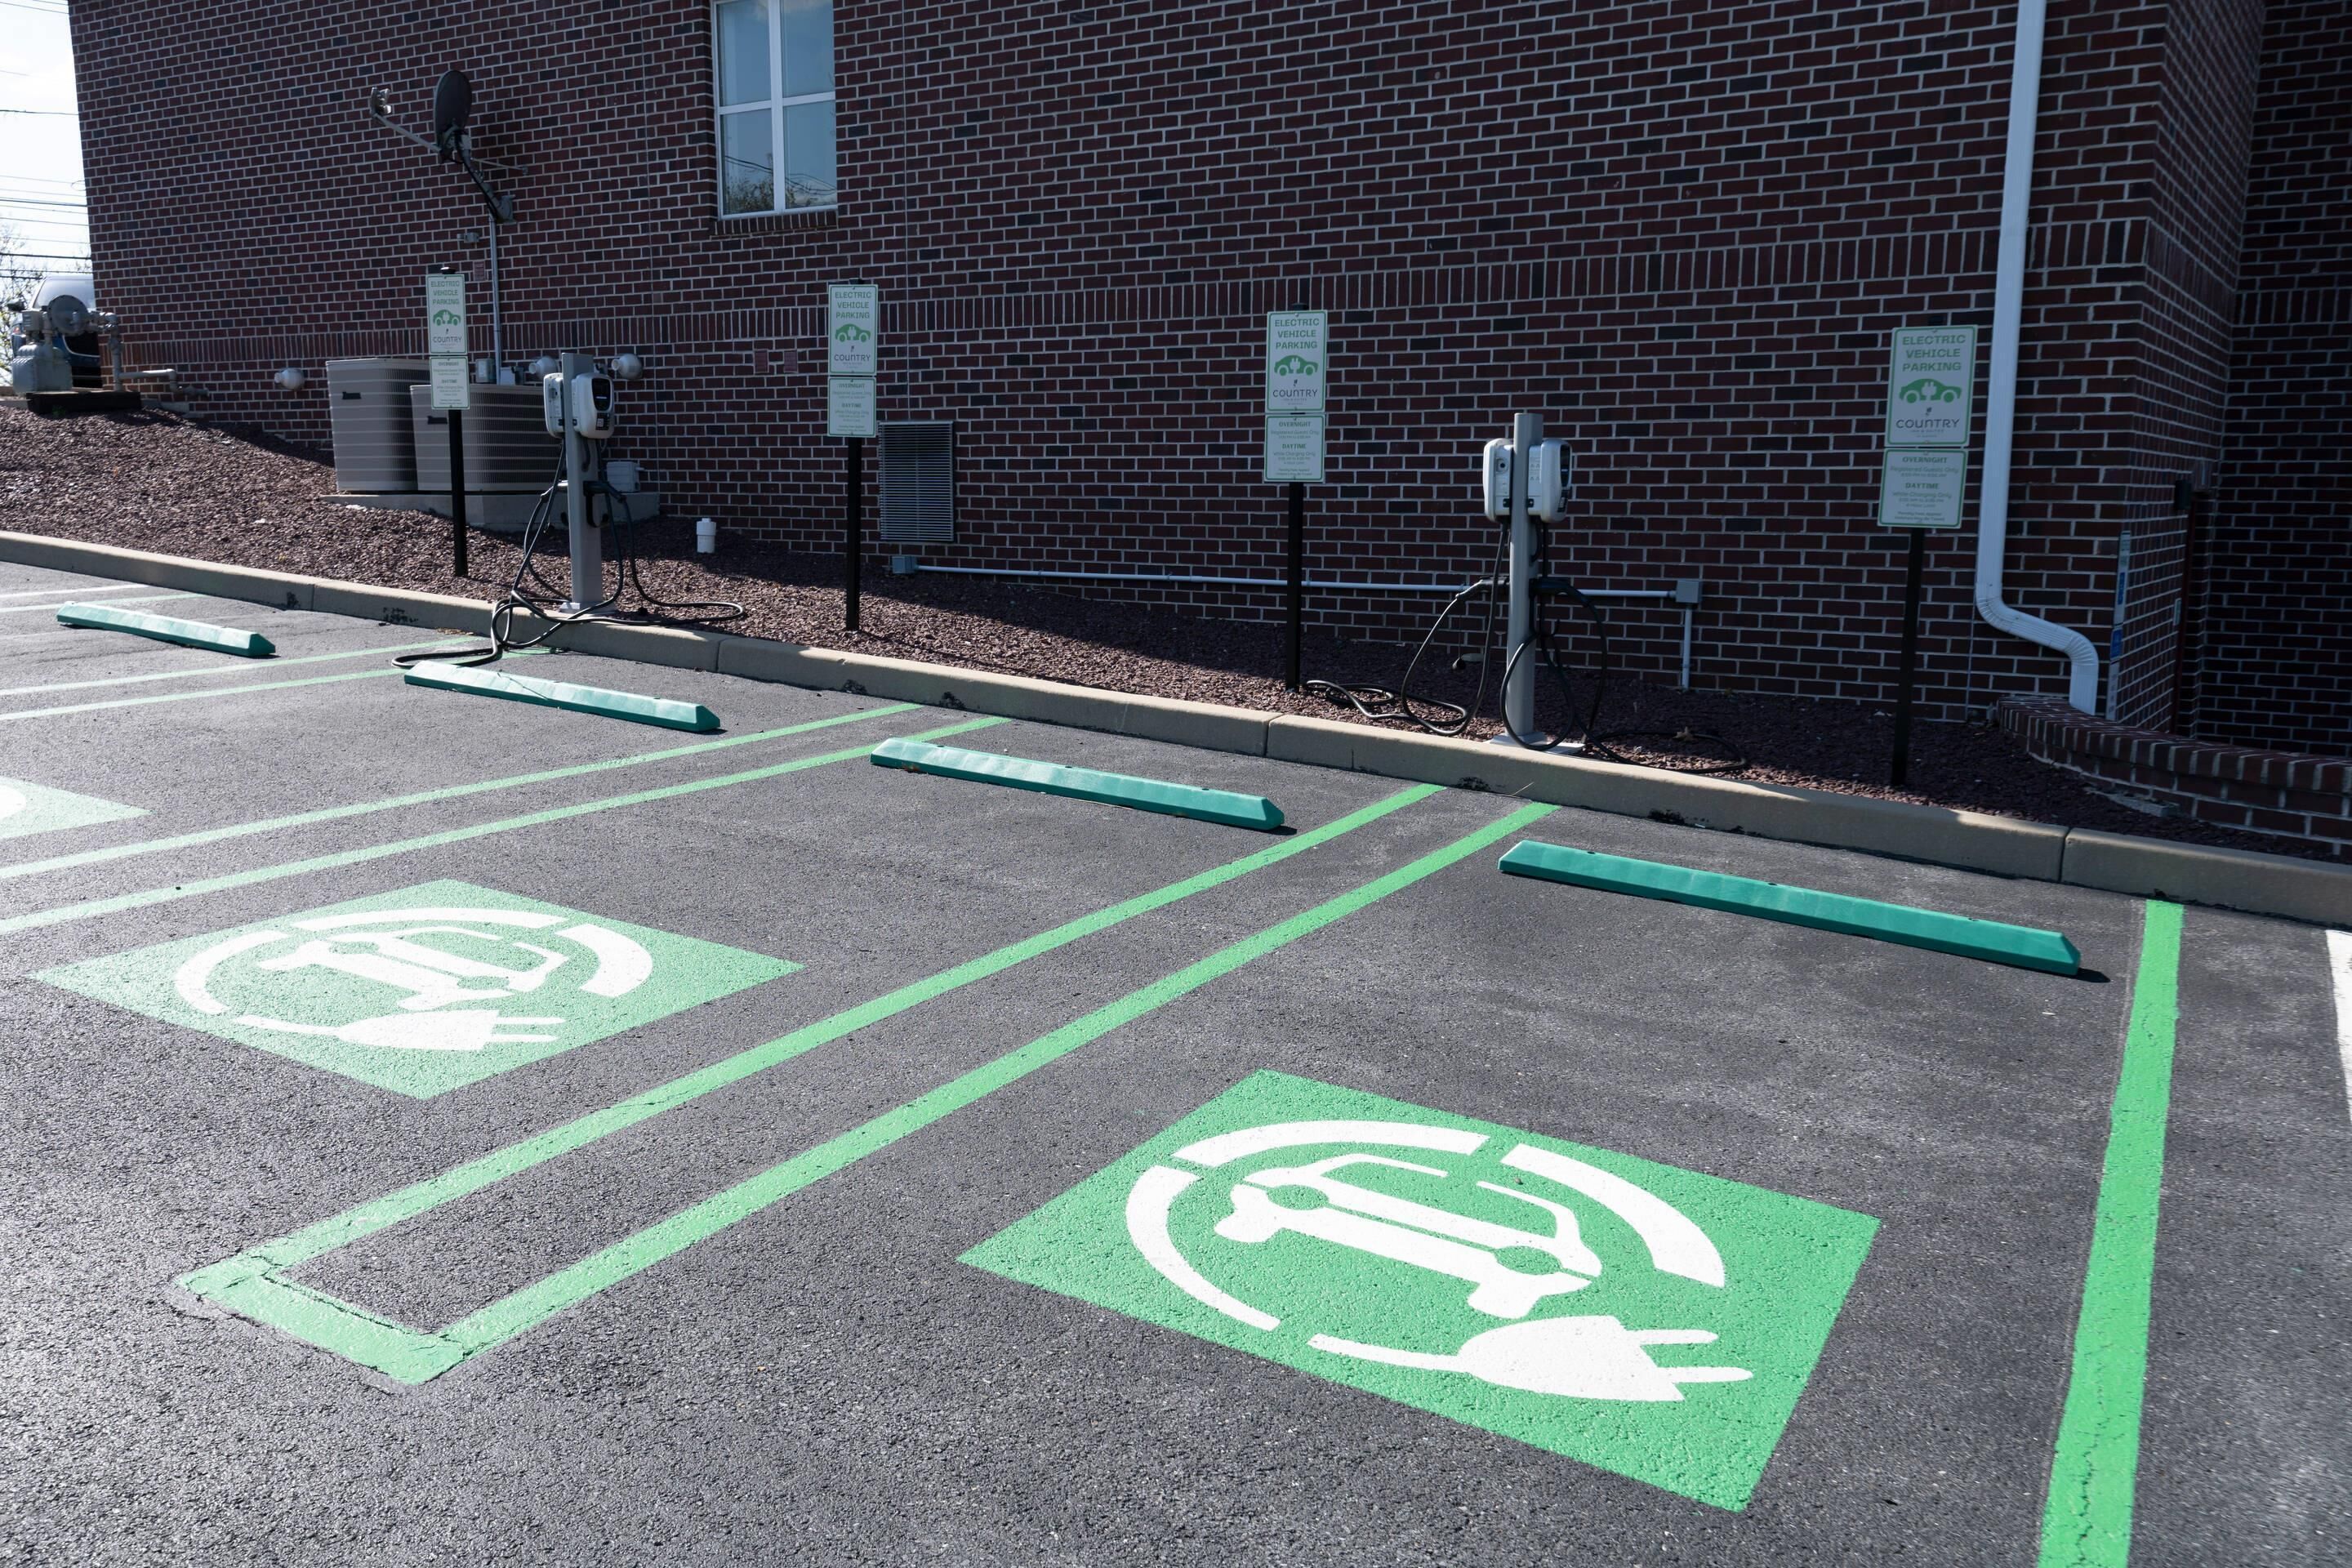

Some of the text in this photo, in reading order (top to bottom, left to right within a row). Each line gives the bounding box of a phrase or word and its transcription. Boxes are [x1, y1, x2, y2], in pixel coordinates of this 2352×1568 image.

[835, 291, 871, 299] ELECTRIC
[1275, 318, 1320, 327] ELECTRIC
[1277, 329, 1316, 338] VEHICLE
[1902, 334, 1966, 345] ELECTRIC
[1276, 341, 1317, 350] PARKING
[1906, 348, 1961, 359] VEHICLE
[1902, 362, 1962, 372] PARKING
